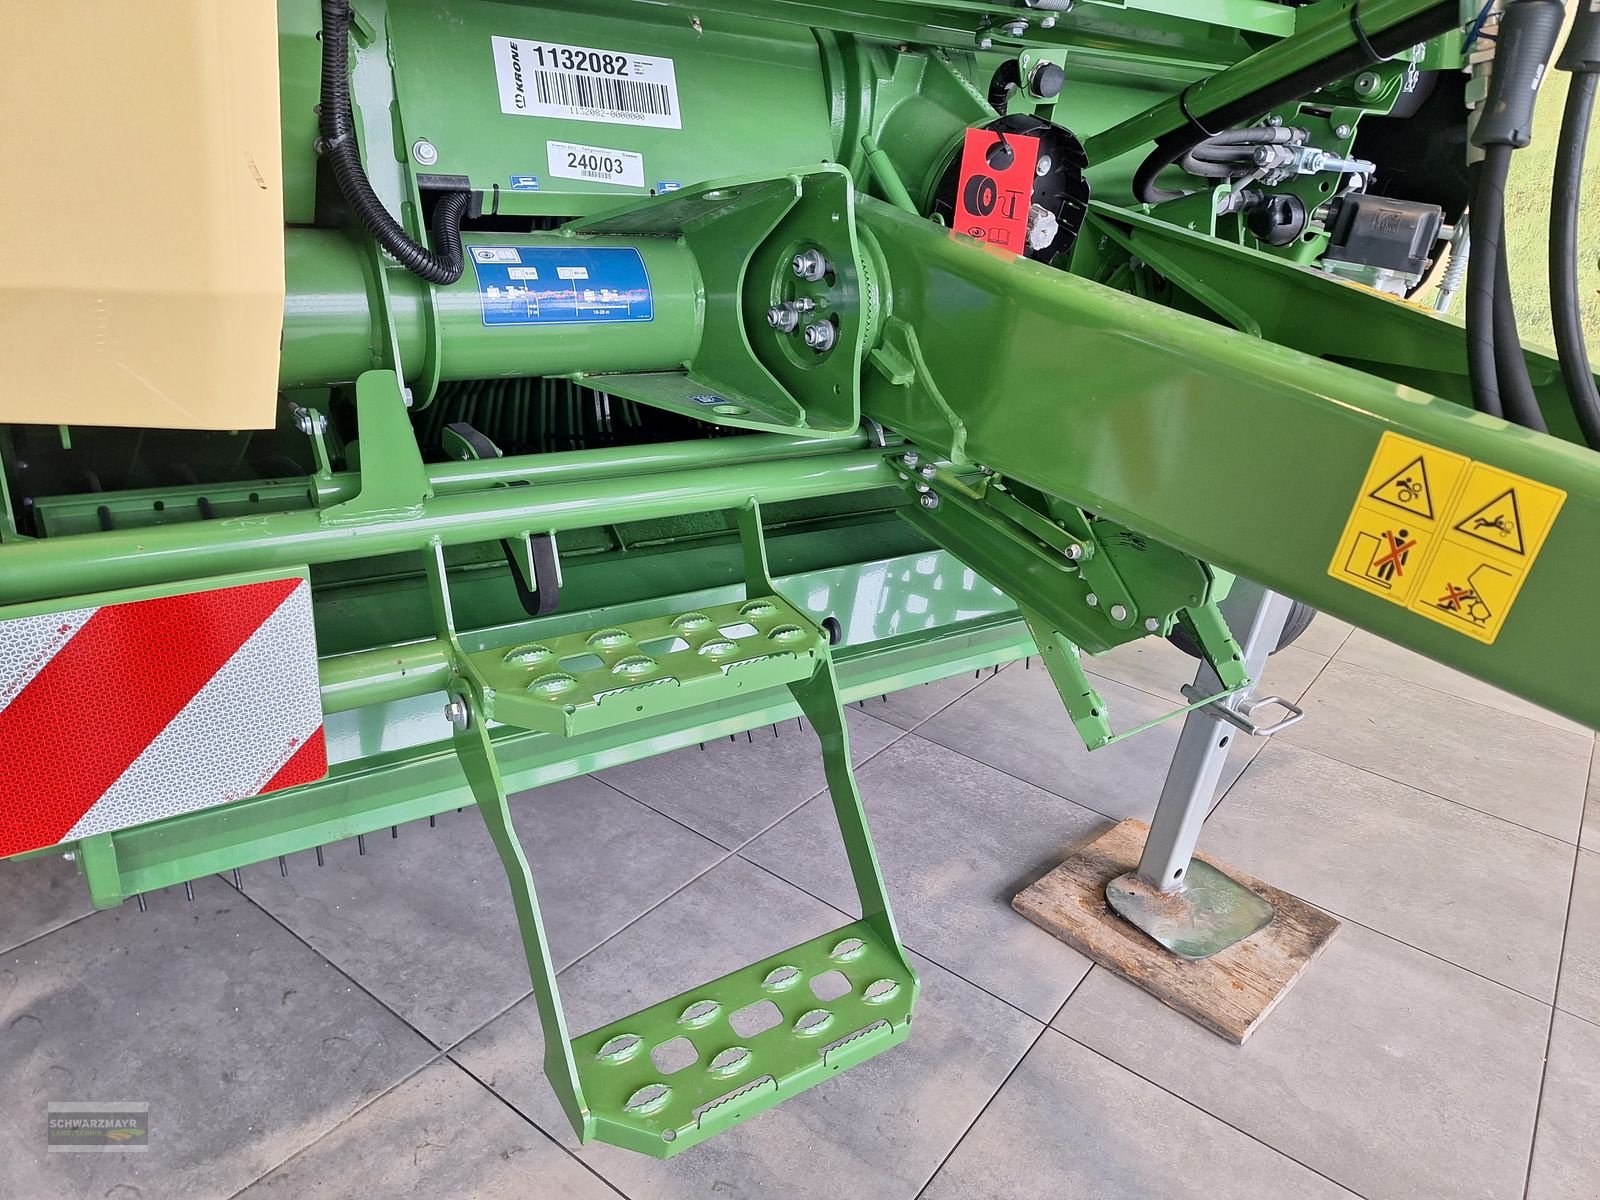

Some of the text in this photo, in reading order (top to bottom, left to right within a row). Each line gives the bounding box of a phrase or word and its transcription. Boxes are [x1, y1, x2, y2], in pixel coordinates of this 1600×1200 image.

[510, 41, 526, 93] KRONE
[533, 46, 629, 76] 1132082
[567, 152, 624, 174] 240/03
